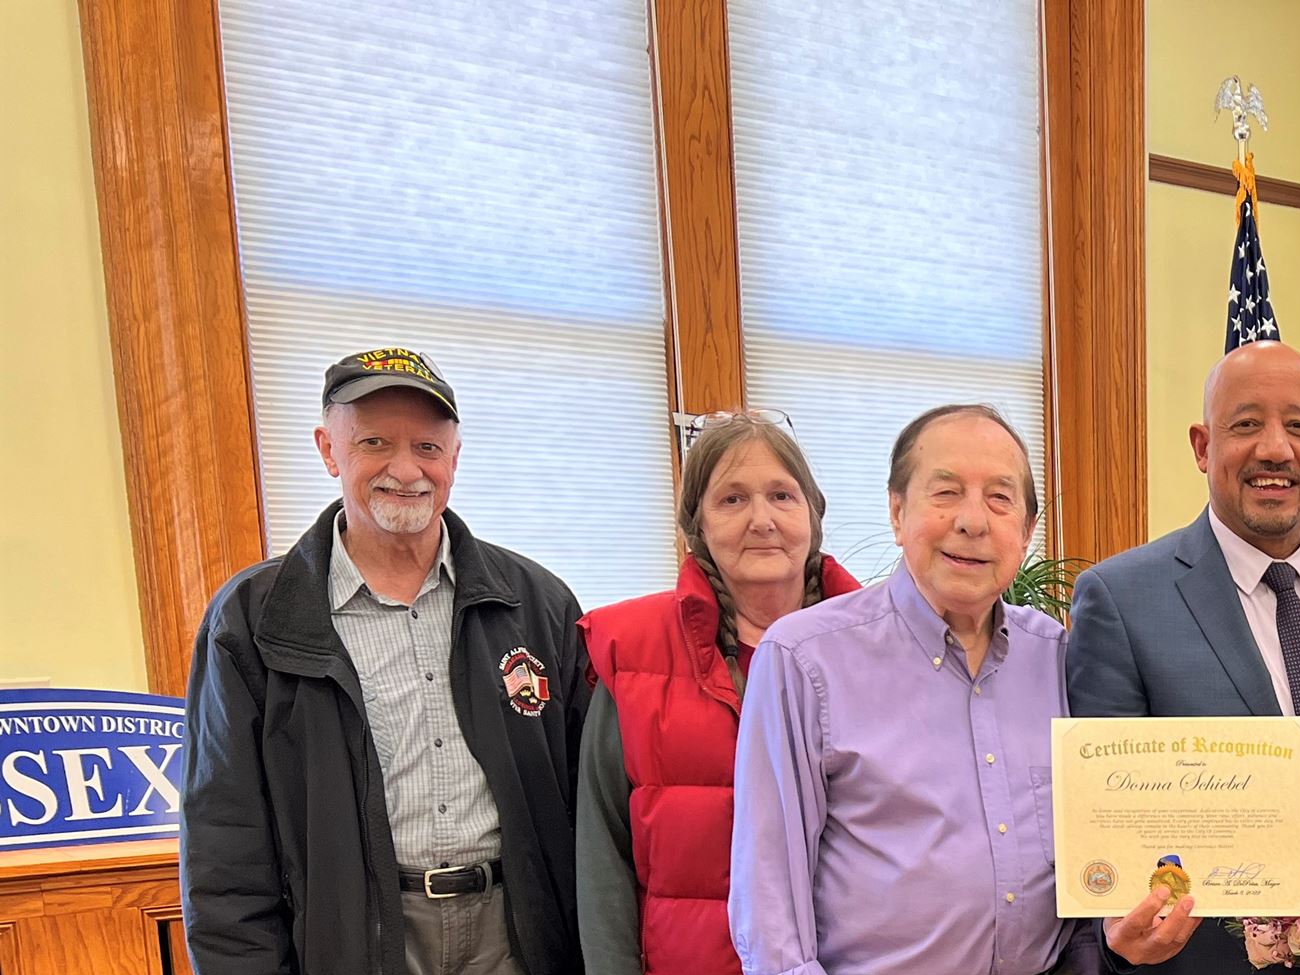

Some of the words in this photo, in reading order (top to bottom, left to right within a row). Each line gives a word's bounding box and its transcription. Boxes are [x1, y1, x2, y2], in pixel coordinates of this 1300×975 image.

[1080, 738, 1166, 760] Certificate
[1171, 737, 1187, 753] of
[1192, 736, 1294, 760] Recognition
[0, 744, 184, 828] SEX
[1105, 770, 1172, 792] Donna
[1179, 772, 1252, 795] Schiebel
